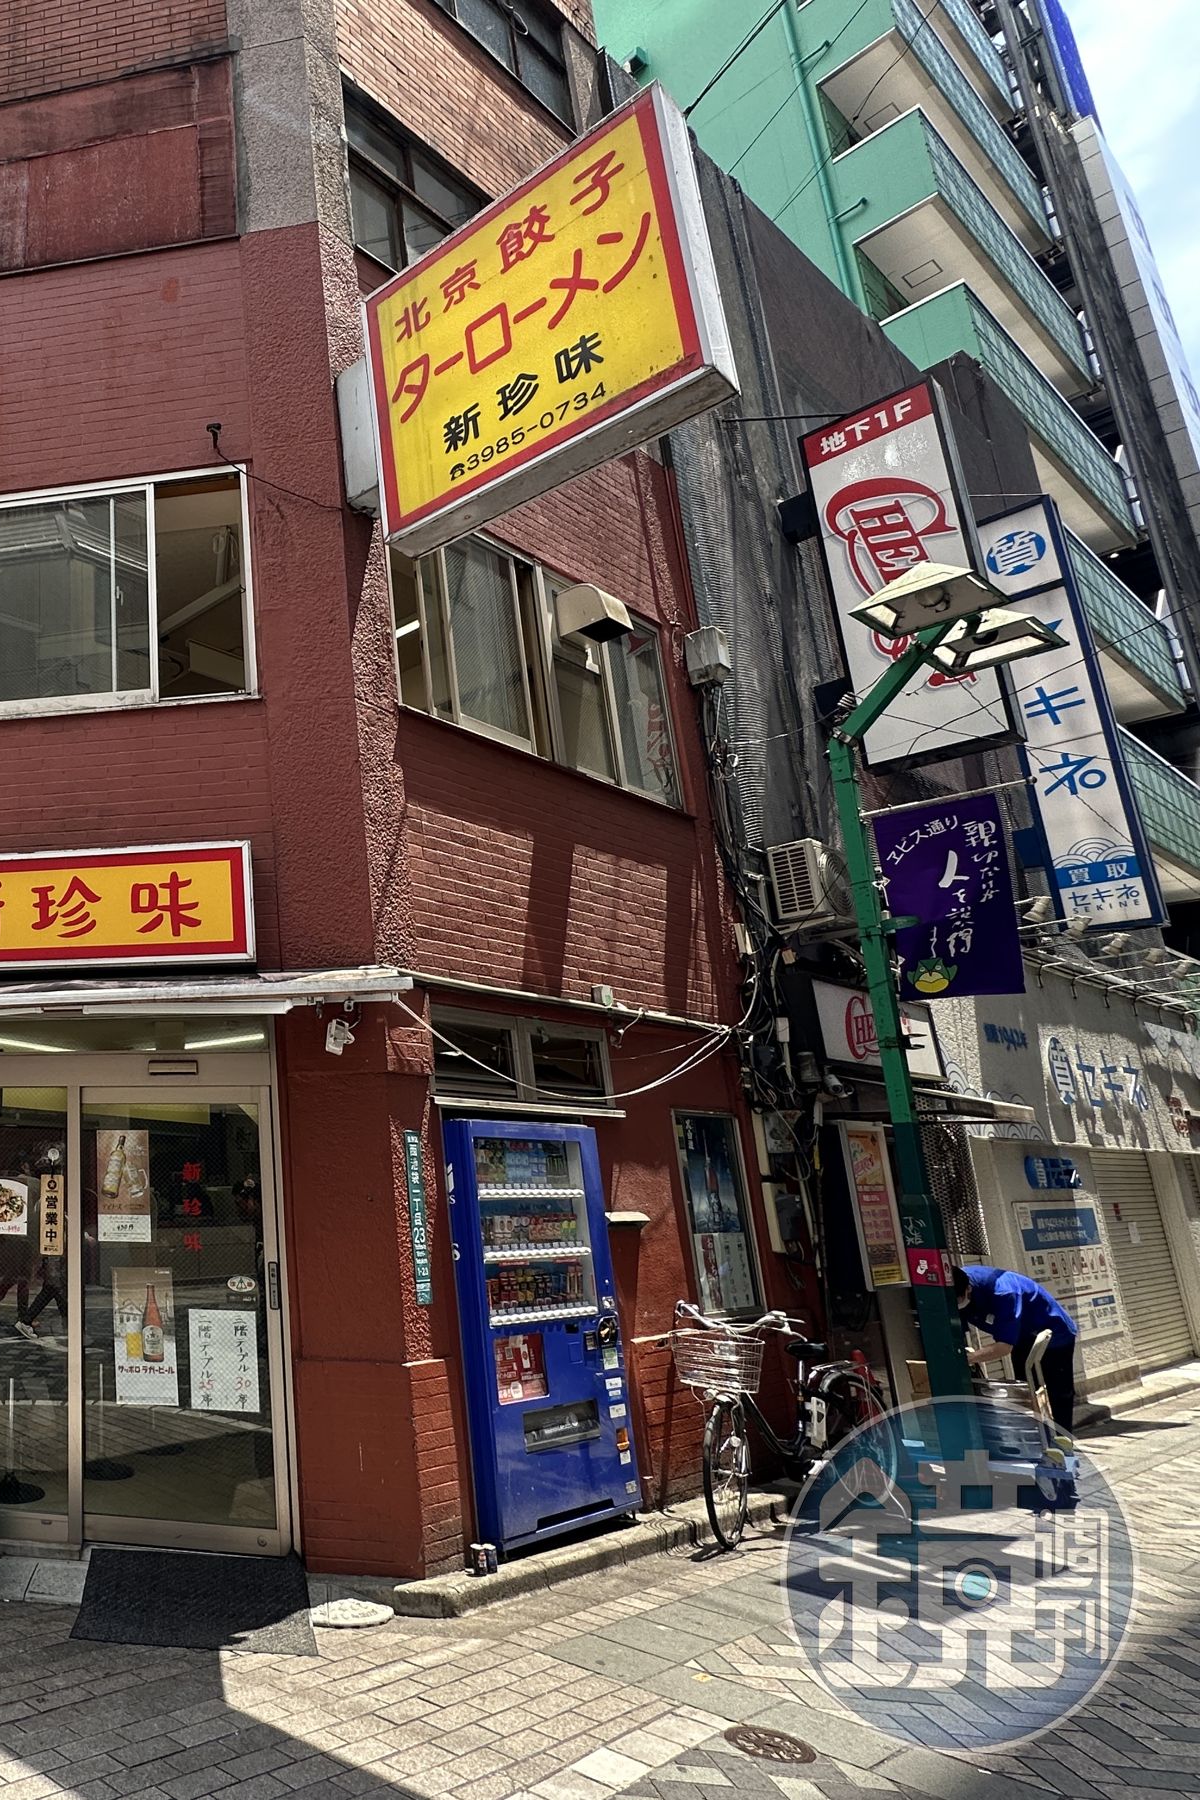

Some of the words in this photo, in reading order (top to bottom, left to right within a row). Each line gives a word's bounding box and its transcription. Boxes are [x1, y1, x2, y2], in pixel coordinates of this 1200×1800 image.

[393, 149, 625, 343] 北京餃子
[392, 211, 651, 424] ターローメン
[443, 332, 604, 454] 新珍味
[464, 381, 607, 472] 3985-0734
[820, 397, 913, 456] 地下1F
[989, 530, 1046, 577] 質
[1067, 884, 1140, 909] セキネ
[1069, 862, 1132, 885] 買取
[1073, 899, 1141, 915] SEKINE
[45, 1195, 59, 1243] 営業中
[413, 1226, 426, 1244] 23
[417, 1266, 429, 1277] 1-23
